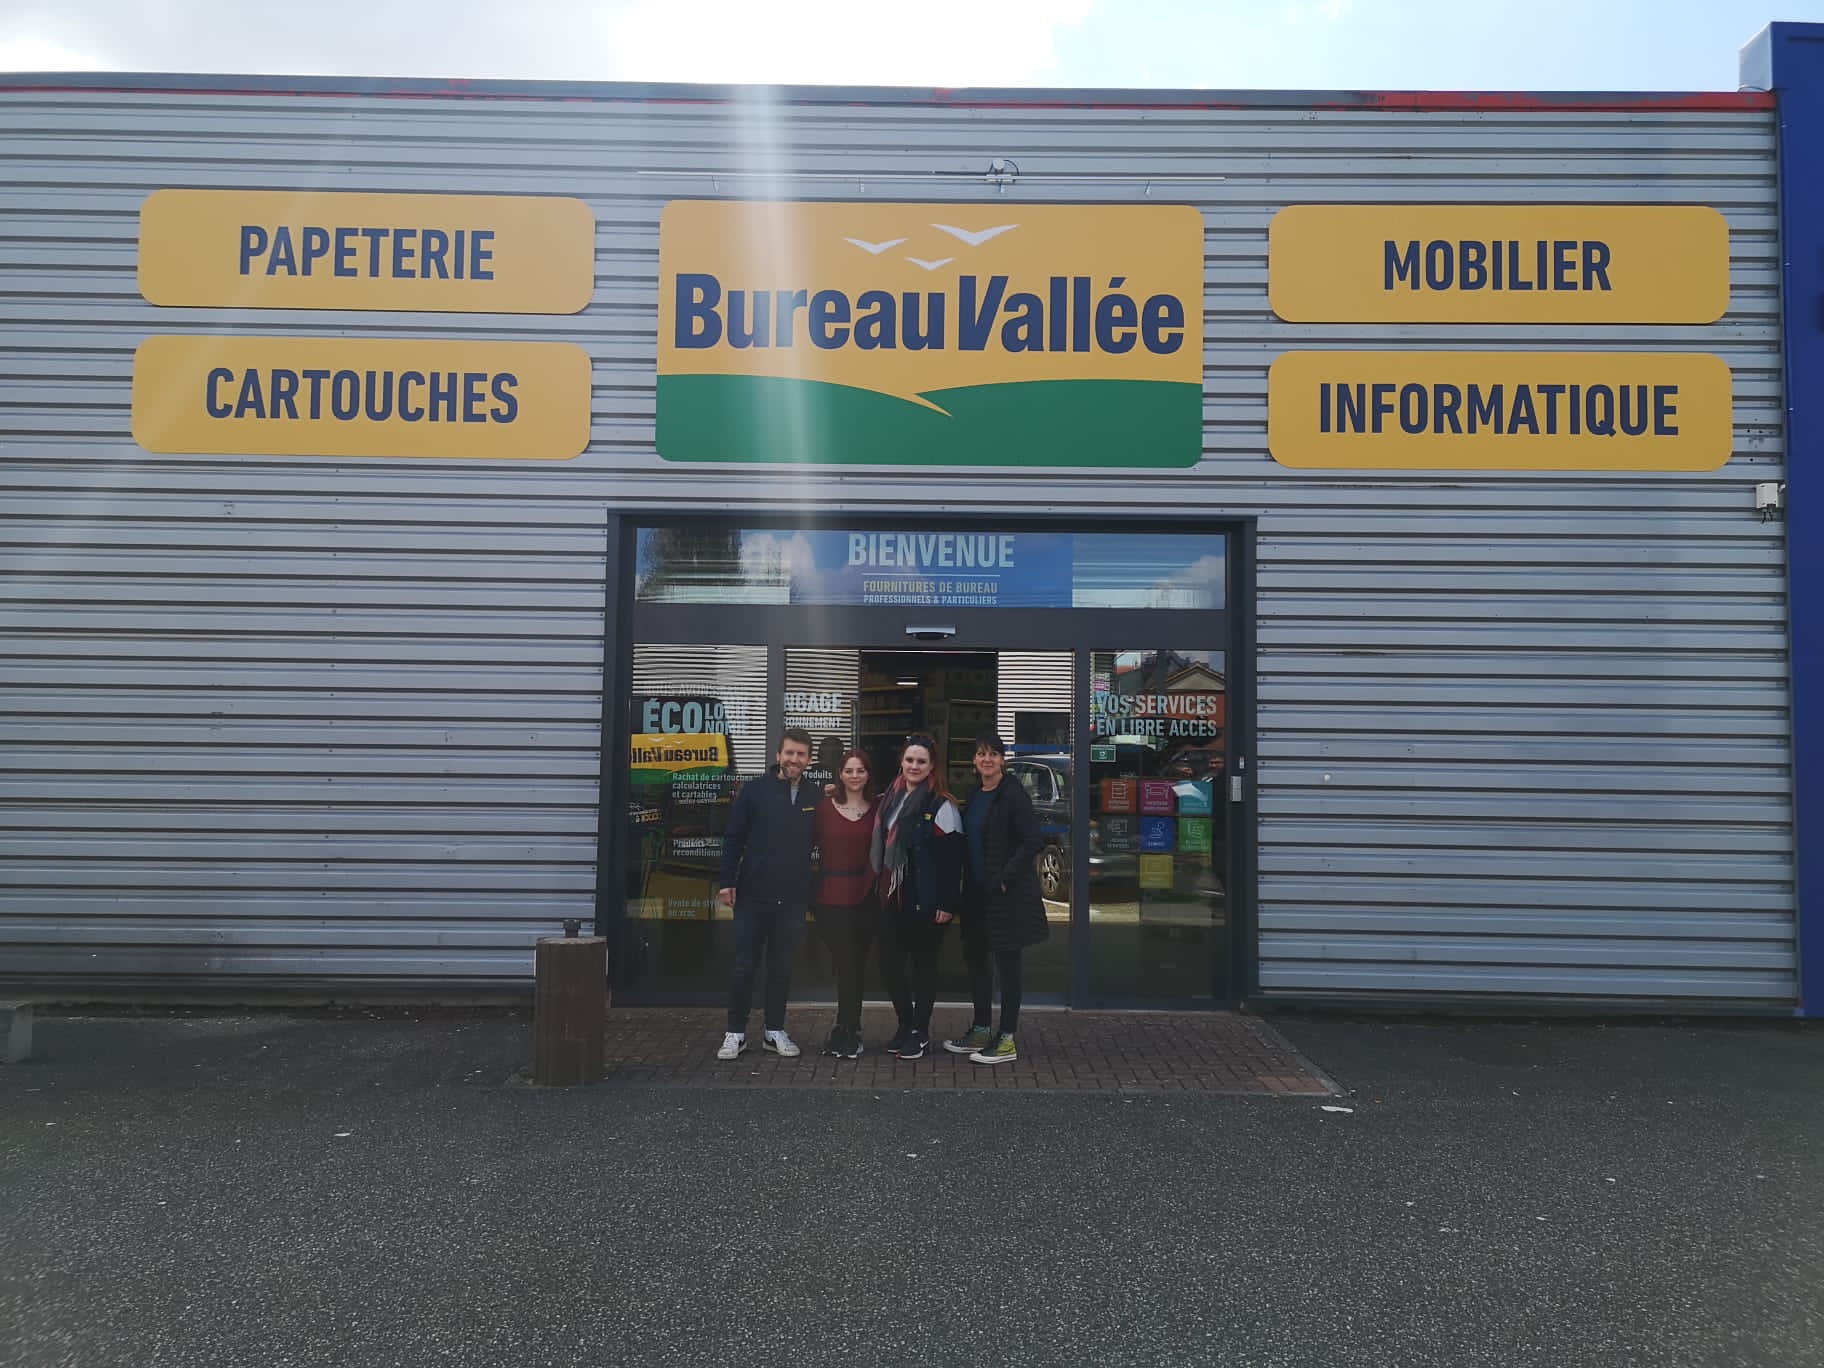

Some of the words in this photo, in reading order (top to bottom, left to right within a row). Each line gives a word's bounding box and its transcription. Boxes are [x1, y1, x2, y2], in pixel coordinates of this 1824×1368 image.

[239, 225, 495, 281] PAPETERIE
[1384, 239, 1612, 291] MOBILIER
[674, 273, 945, 351] Bureau
[957, 275, 1185, 355] Vallée
[206, 367, 519, 424] CARTOUCHES
[1320, 382, 1679, 437] INFORMATIQUE
[848, 533, 1016, 568] BIENVENUE
[863, 580, 936, 593] FOURNITURES
[939, 581, 953, 593] DE
[956, 581, 998, 594] BUREAU
[863, 594, 931, 605] PROFESSIONNELS
[933, 596, 939, 605] &
[942, 595, 997, 606] PARTICULIERS
[642, 697, 703, 734] ÉCO
[1096, 695, 1131, 714] VOS
[1134, 695, 1217, 715] SERVICES
[1097, 718, 1116, 736] EN
[1121, 719, 1165, 736] LIBRE
